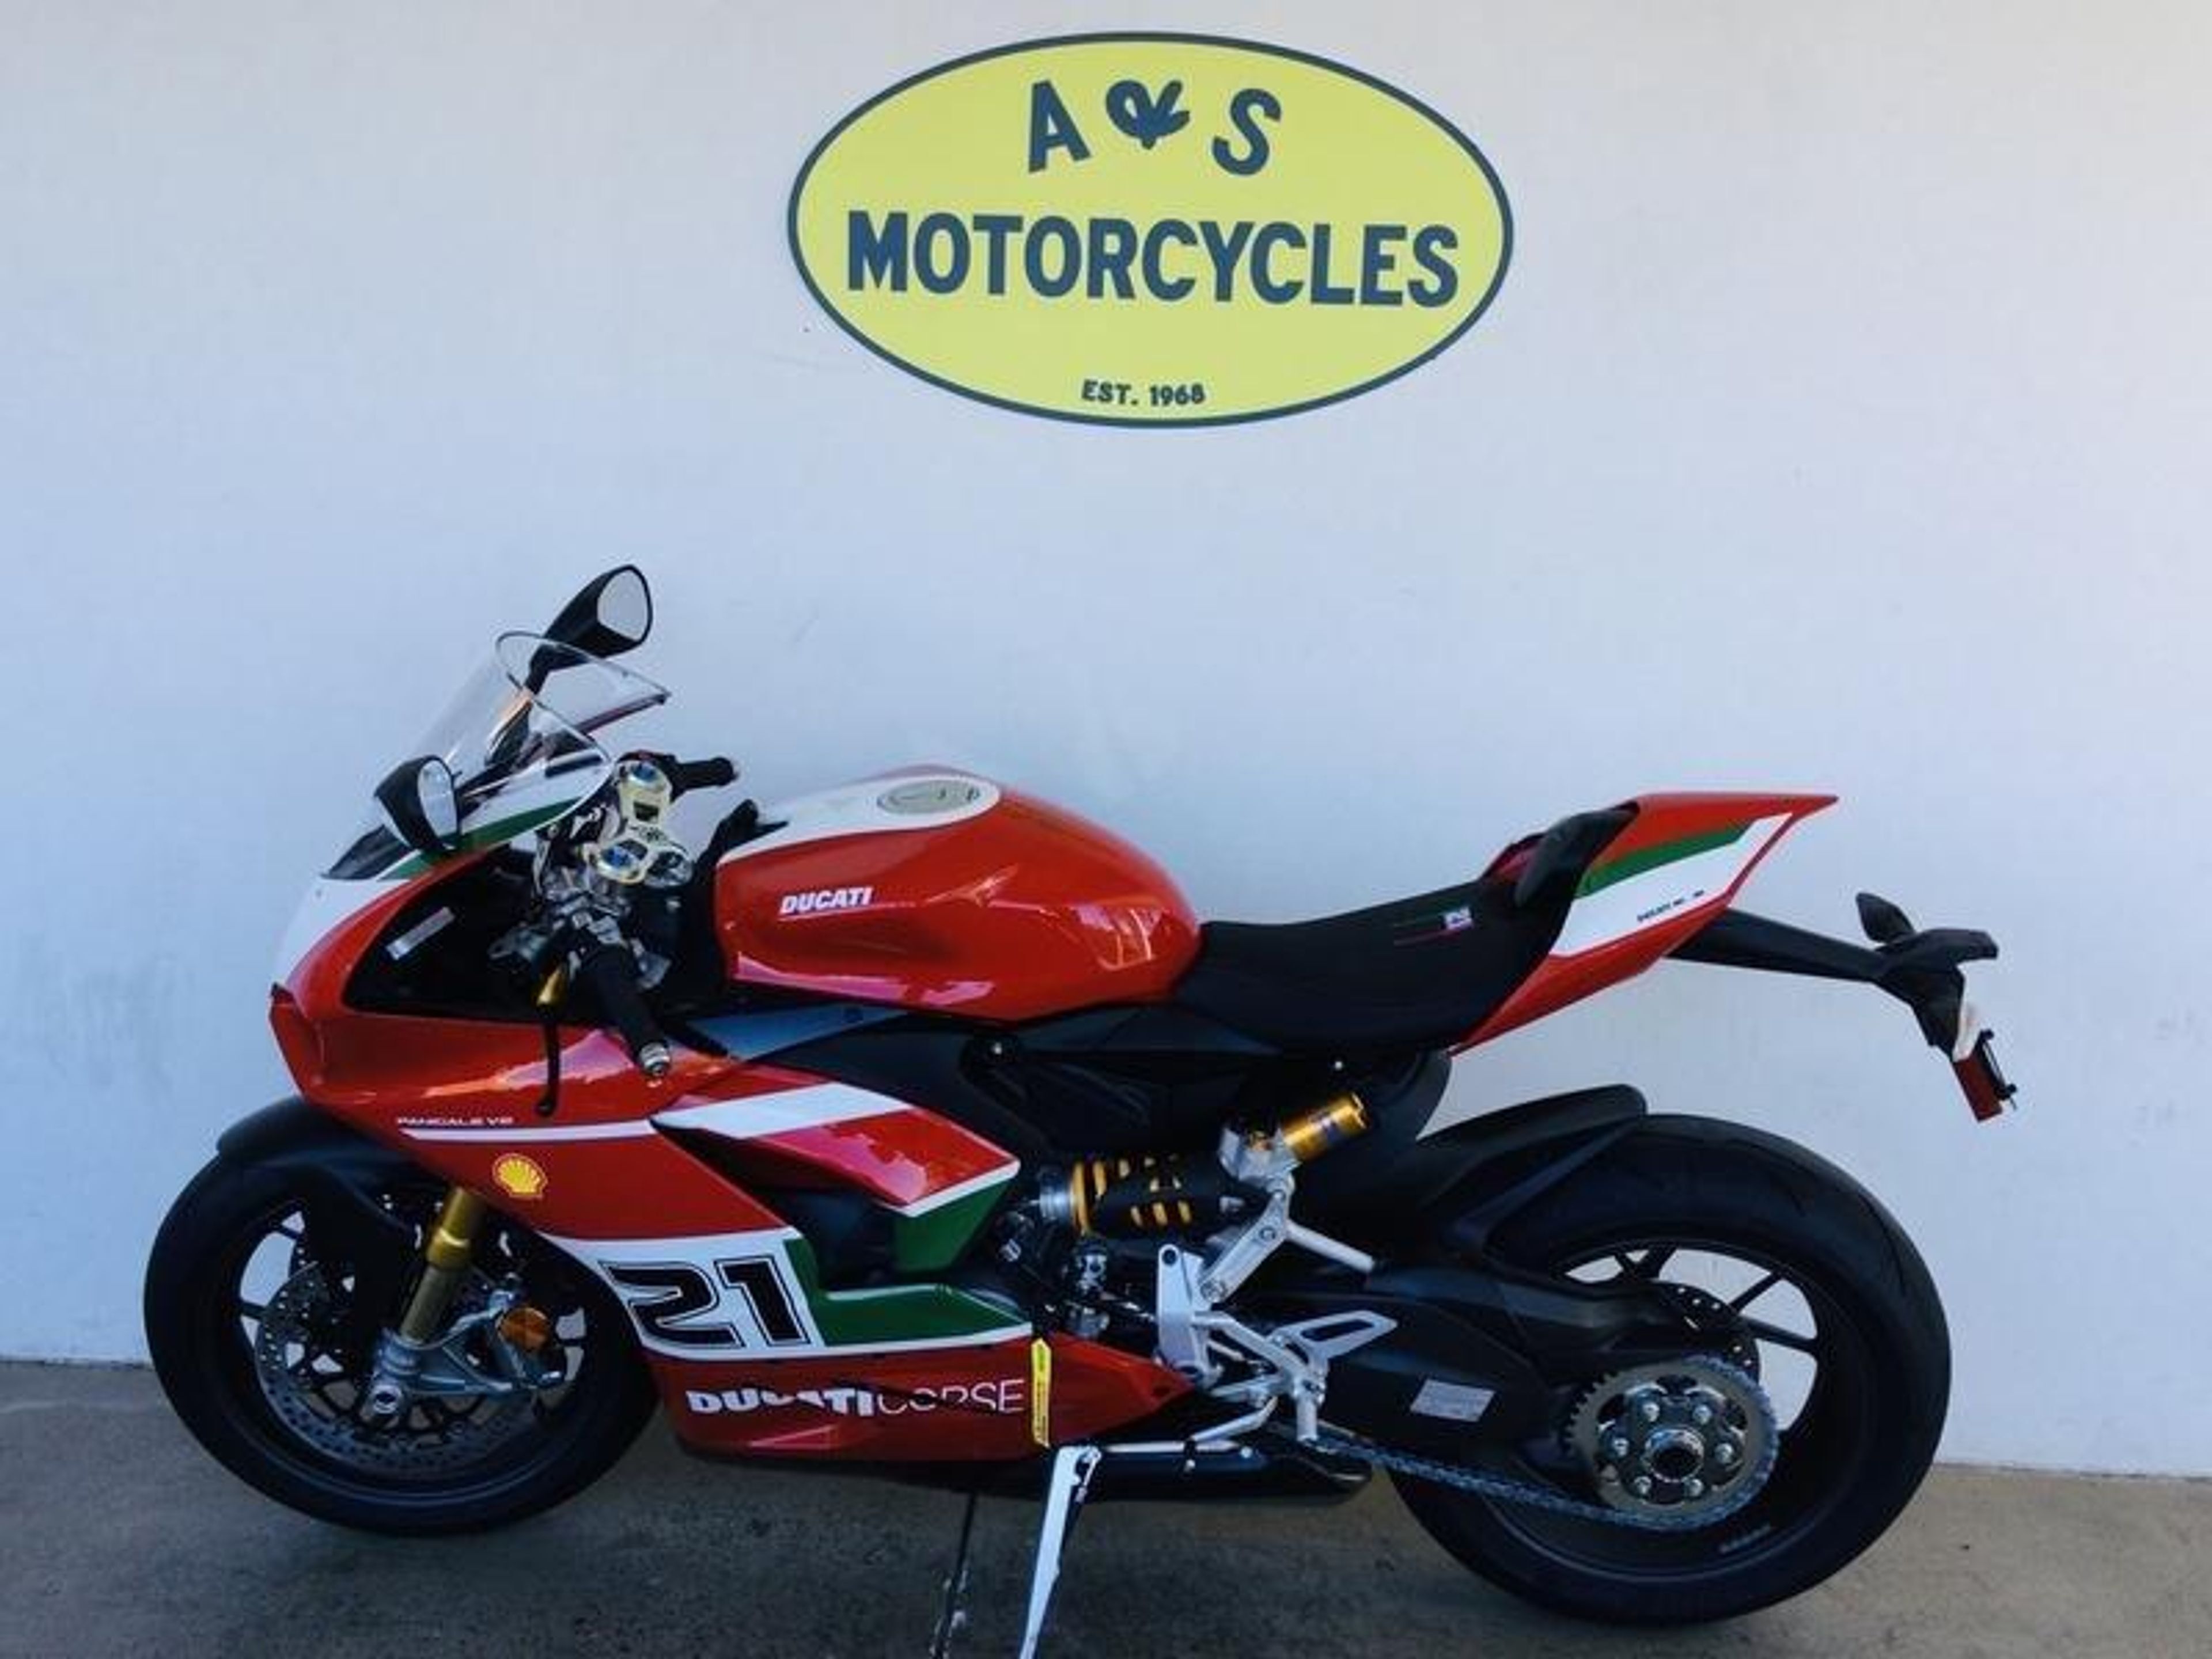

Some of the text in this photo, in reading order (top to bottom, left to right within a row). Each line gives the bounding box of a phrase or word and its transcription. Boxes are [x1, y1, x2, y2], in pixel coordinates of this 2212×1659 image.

[1029, 79, 1091, 173] A
[1212, 88, 1282, 175] S
[847, 210, 1460, 309] MOTORCYCLES
[1081, 378, 1206, 406] EST. 1968
[779, 887, 873, 914] DUCATI
[598, 1256, 811, 1349] 21
